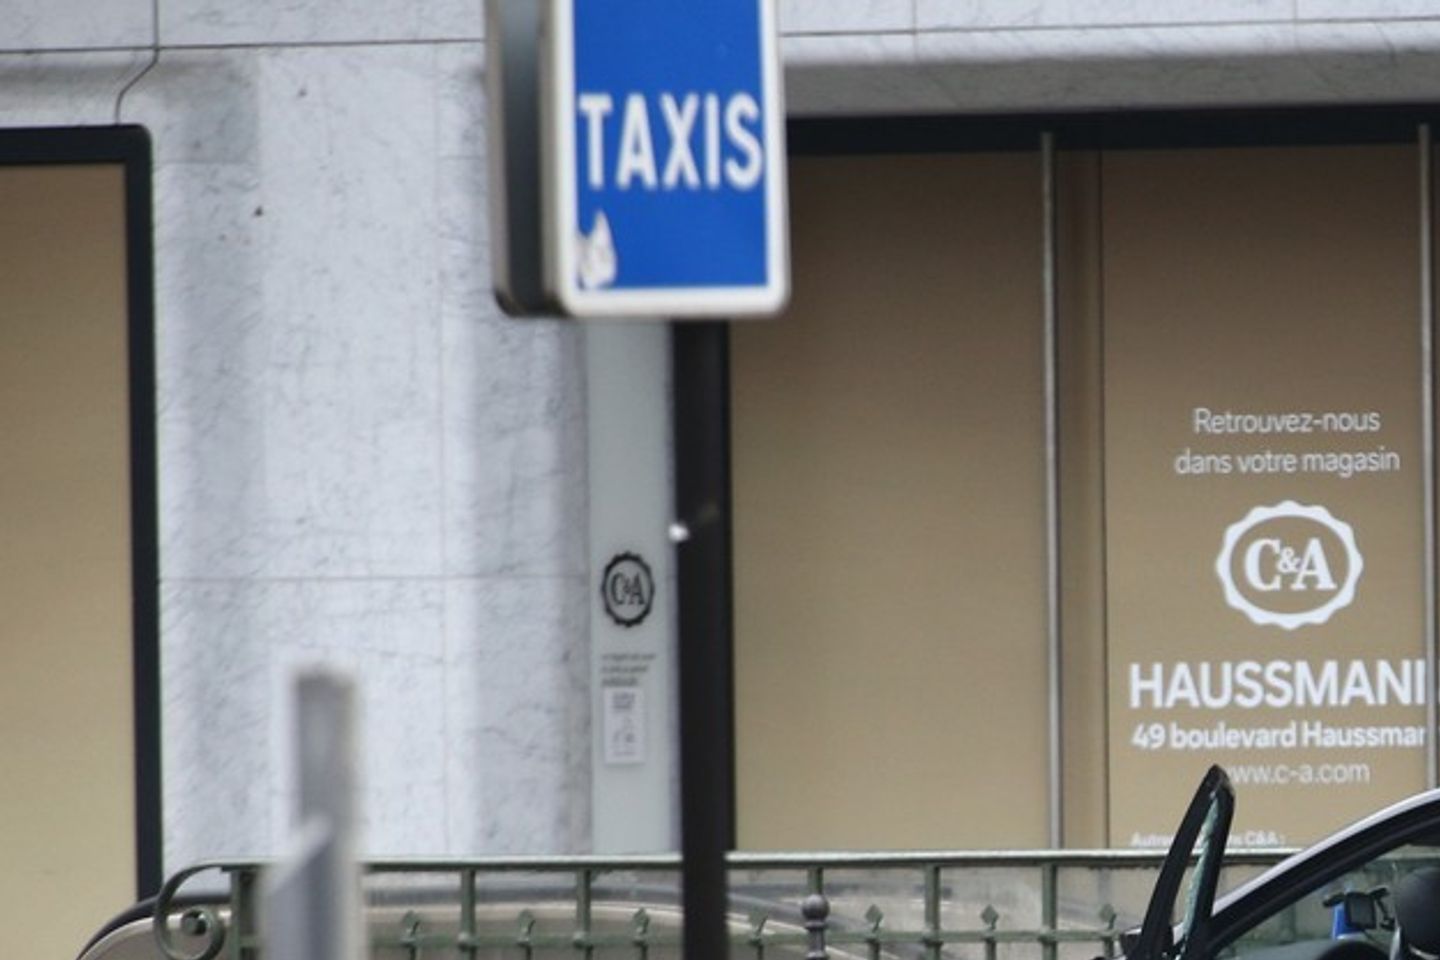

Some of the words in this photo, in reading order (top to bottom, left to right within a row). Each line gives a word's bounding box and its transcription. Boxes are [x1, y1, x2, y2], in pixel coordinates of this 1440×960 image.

[578, 92, 764, 190] TAXIS
[1193, 408, 1381, 434] Retrouvez-nous
[1175, 448, 1231, 475] dans
[1237, 450, 1297, 474] votre
[1302, 446, 1401, 478] magasin
[1243, 537, 1337, 592] C&A
[610, 572, 646, 606] C&A
[1132, 723, 1166, 749] 49
[1171, 721, 1297, 749] boulevard
[1227, 761, 1371, 785] ww.c-a.com
